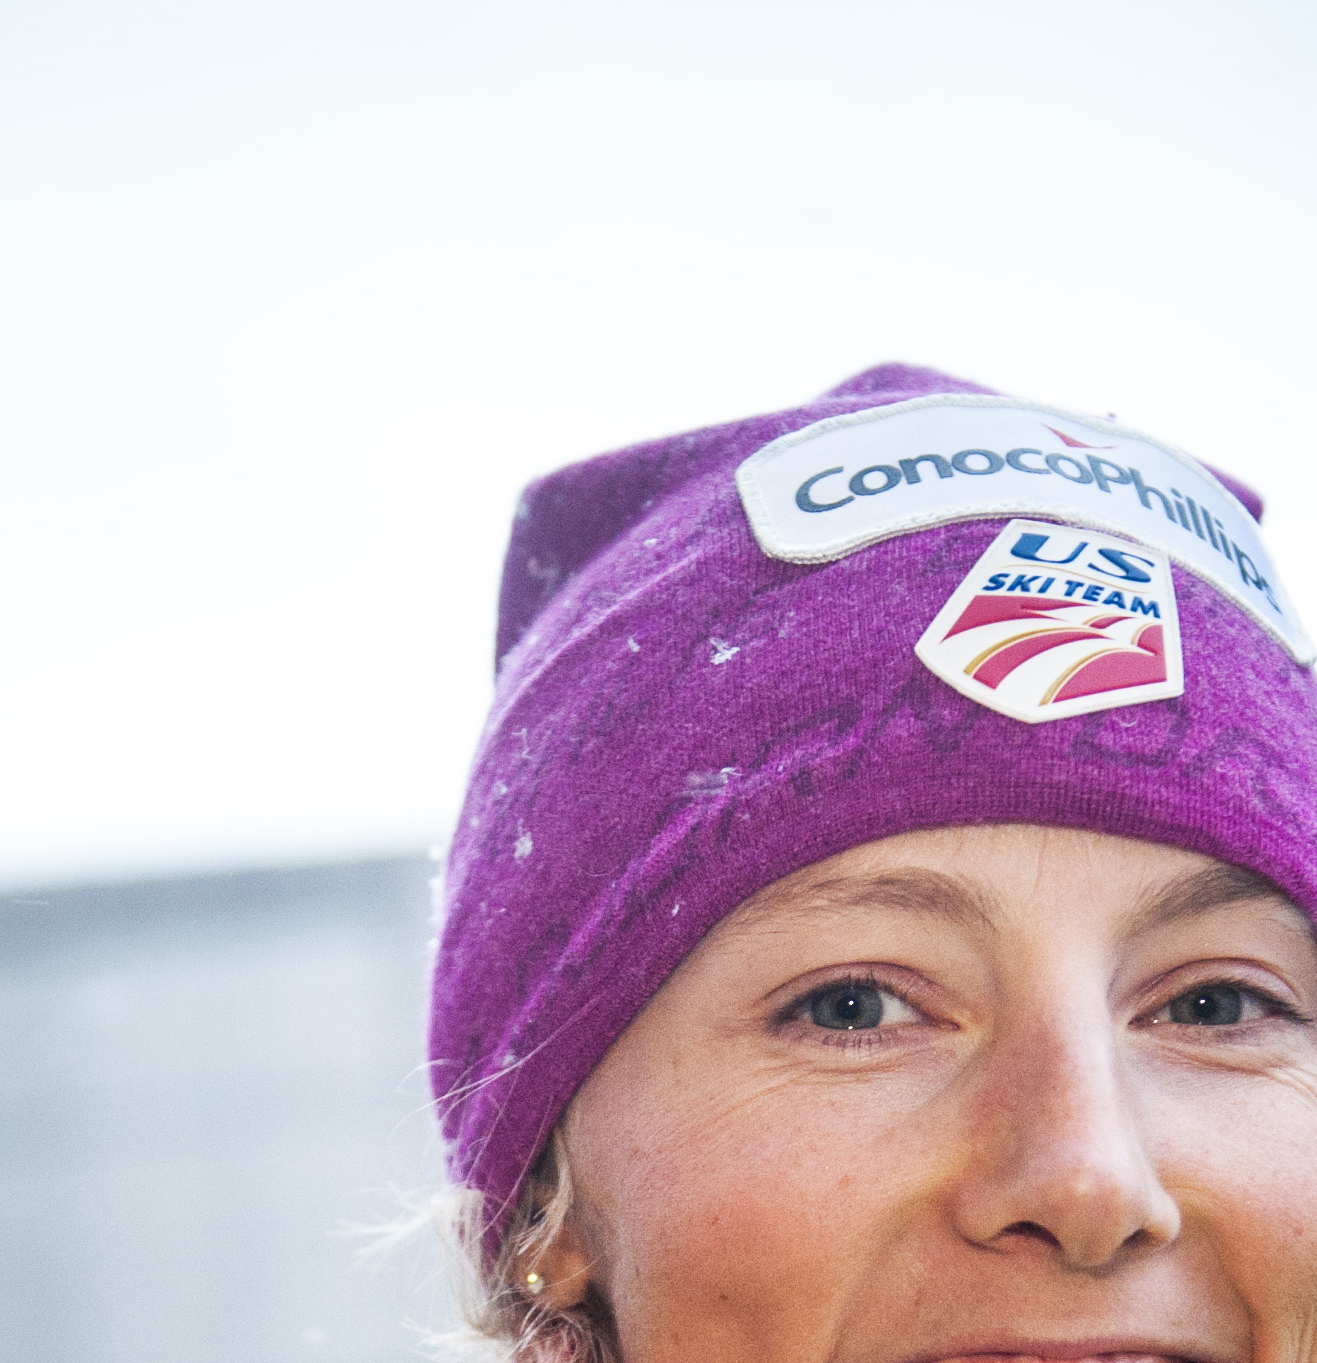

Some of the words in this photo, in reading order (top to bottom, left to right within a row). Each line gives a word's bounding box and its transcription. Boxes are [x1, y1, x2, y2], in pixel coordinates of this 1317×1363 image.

[1009, 532, 1156, 584] US
[981, 572, 1057, 595] SKI
[1062, 579, 1162, 620] TEAM
